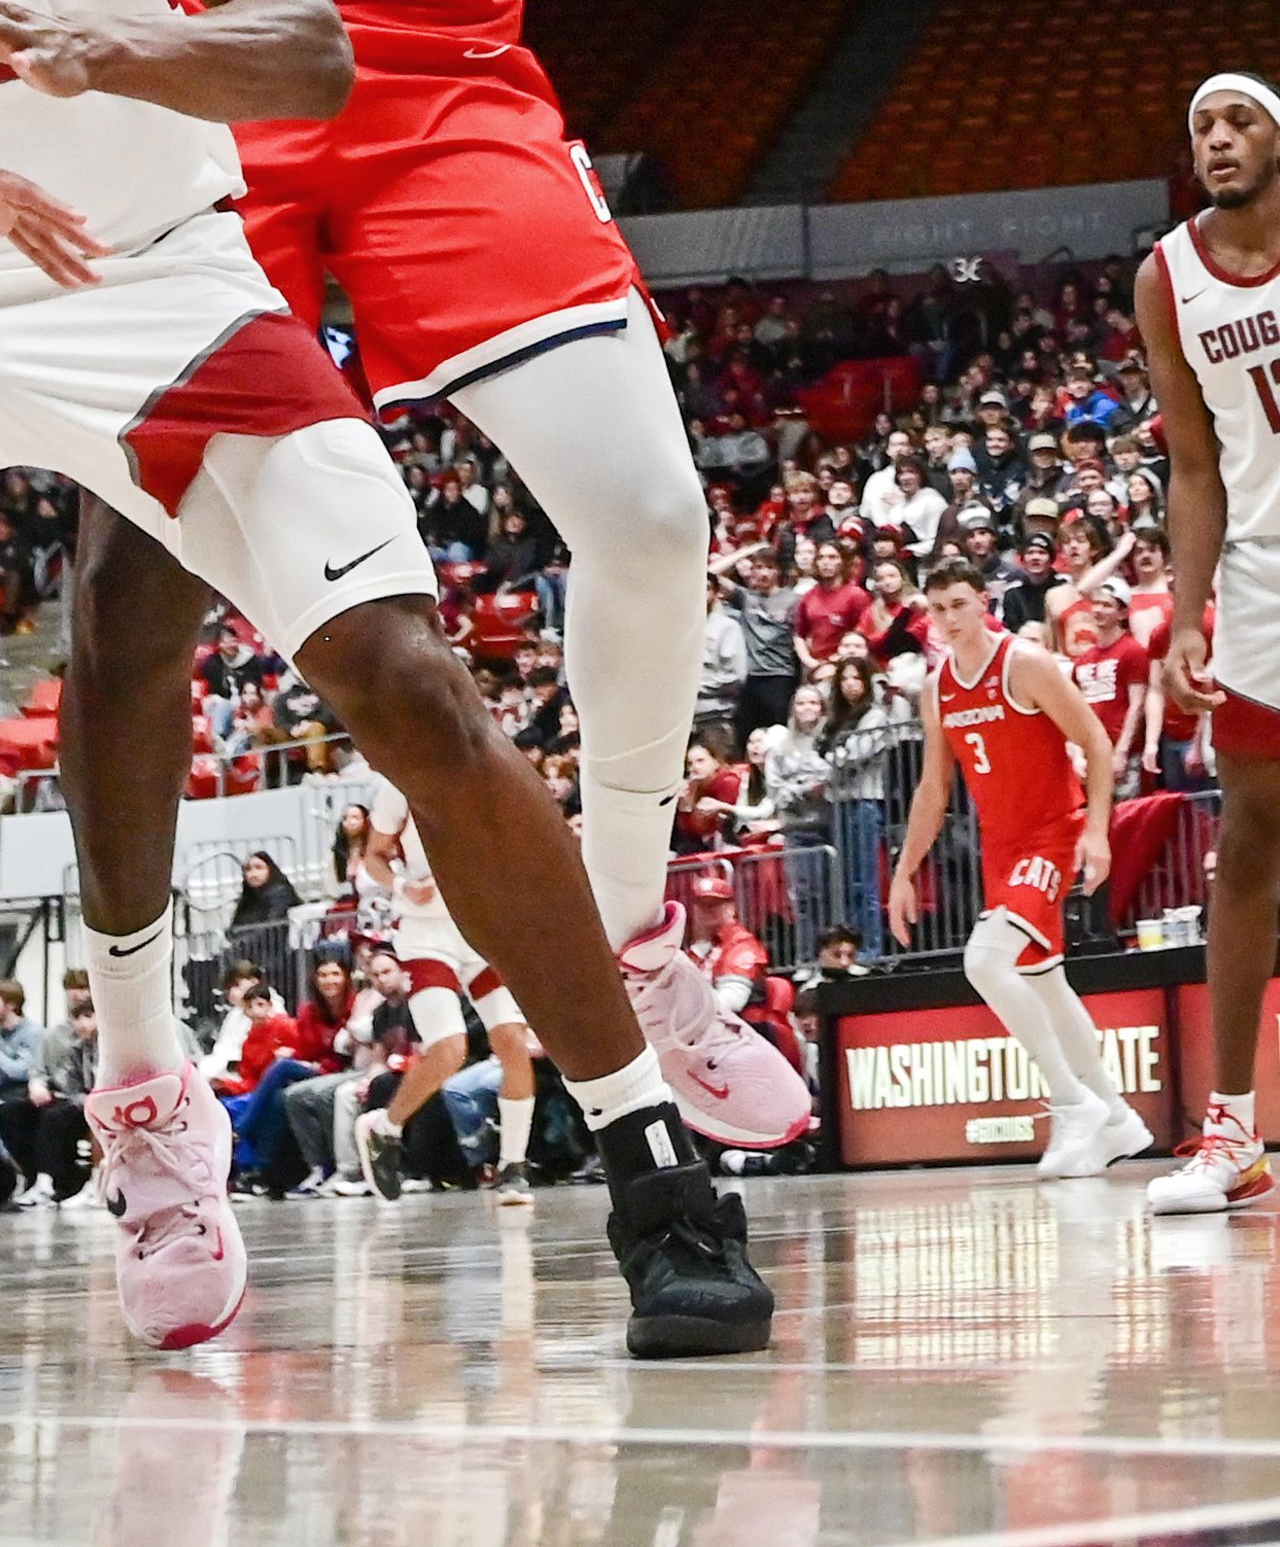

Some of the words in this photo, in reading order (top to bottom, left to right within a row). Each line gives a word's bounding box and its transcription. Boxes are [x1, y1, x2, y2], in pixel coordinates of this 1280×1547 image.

[964, 732, 991, 774] 3
[1008, 856, 1062, 902] CATS
[1095, 1026, 1161, 1093] ATE
